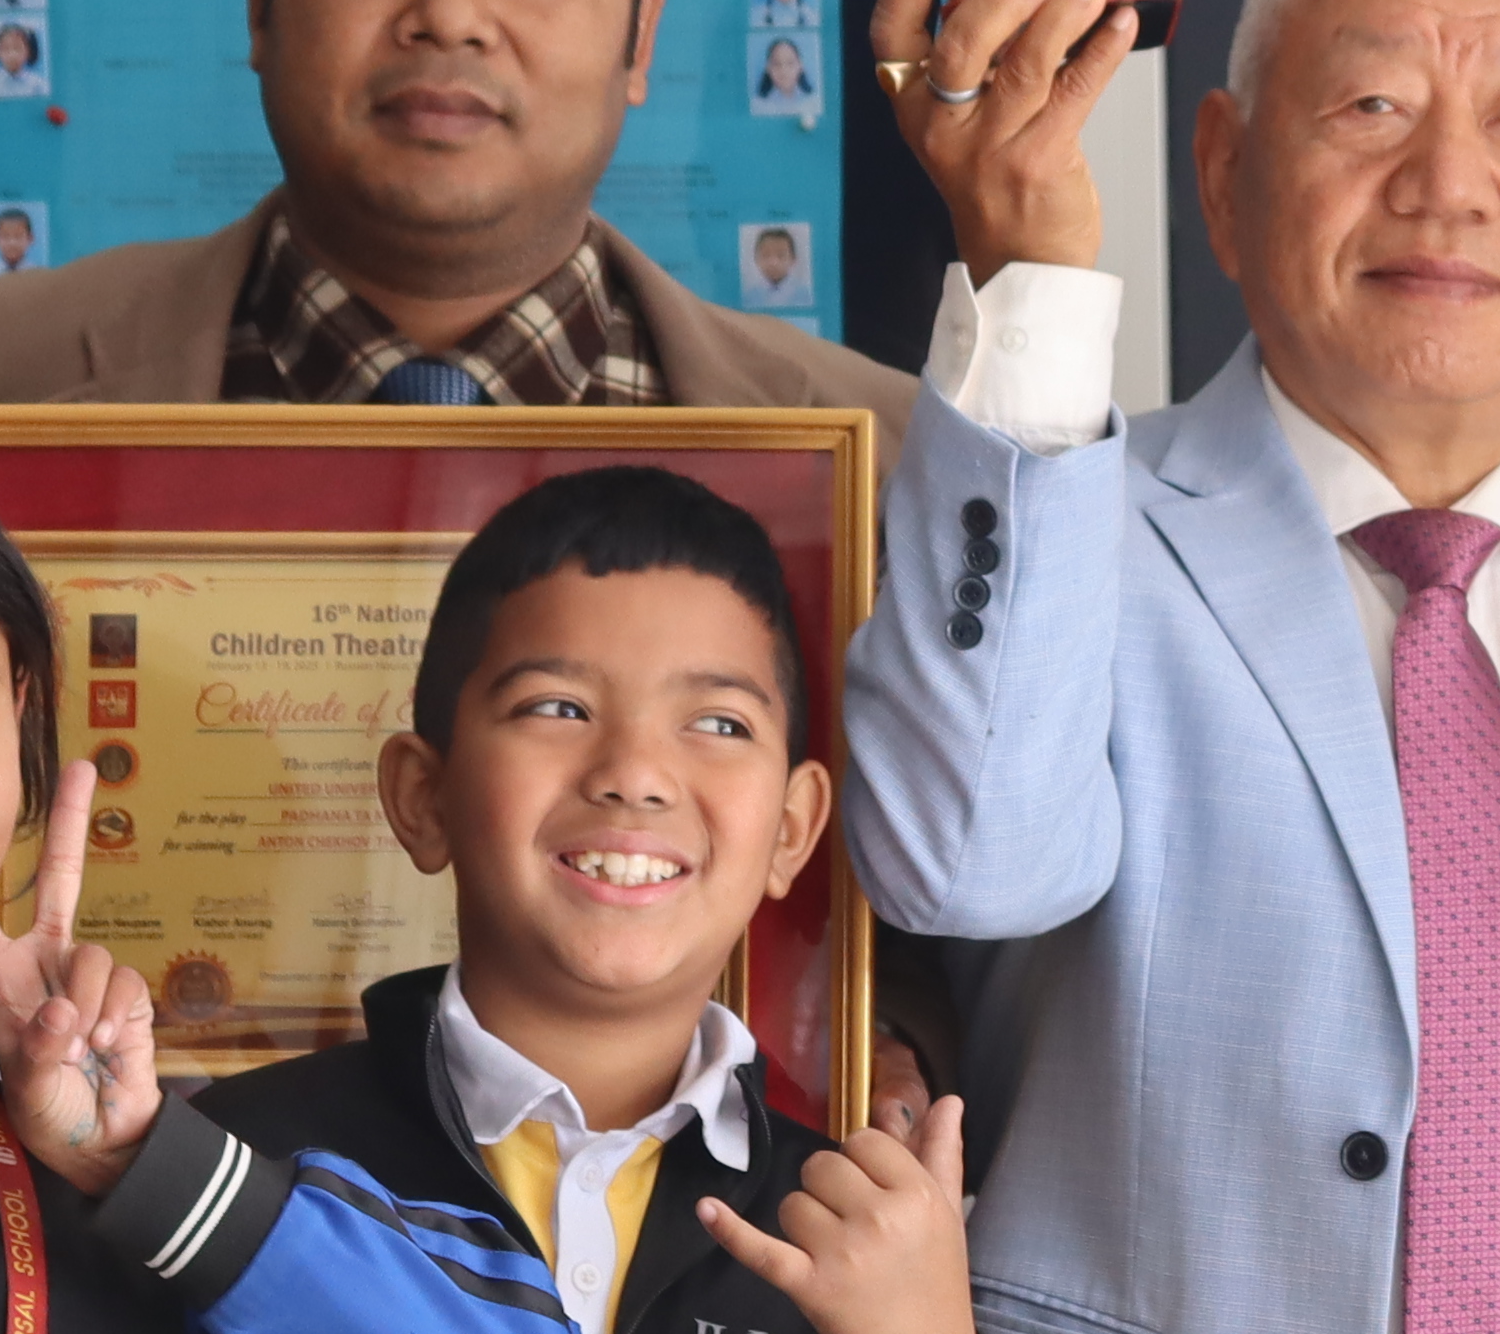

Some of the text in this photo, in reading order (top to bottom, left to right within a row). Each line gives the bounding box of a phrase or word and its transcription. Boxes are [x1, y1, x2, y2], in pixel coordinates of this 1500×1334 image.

[312, 603, 352, 624] 16th
[210, 632, 325, 657] Children
[195, 681, 391, 738] Certificate of
[2, 1188, 34, 1277] SCHOOL
